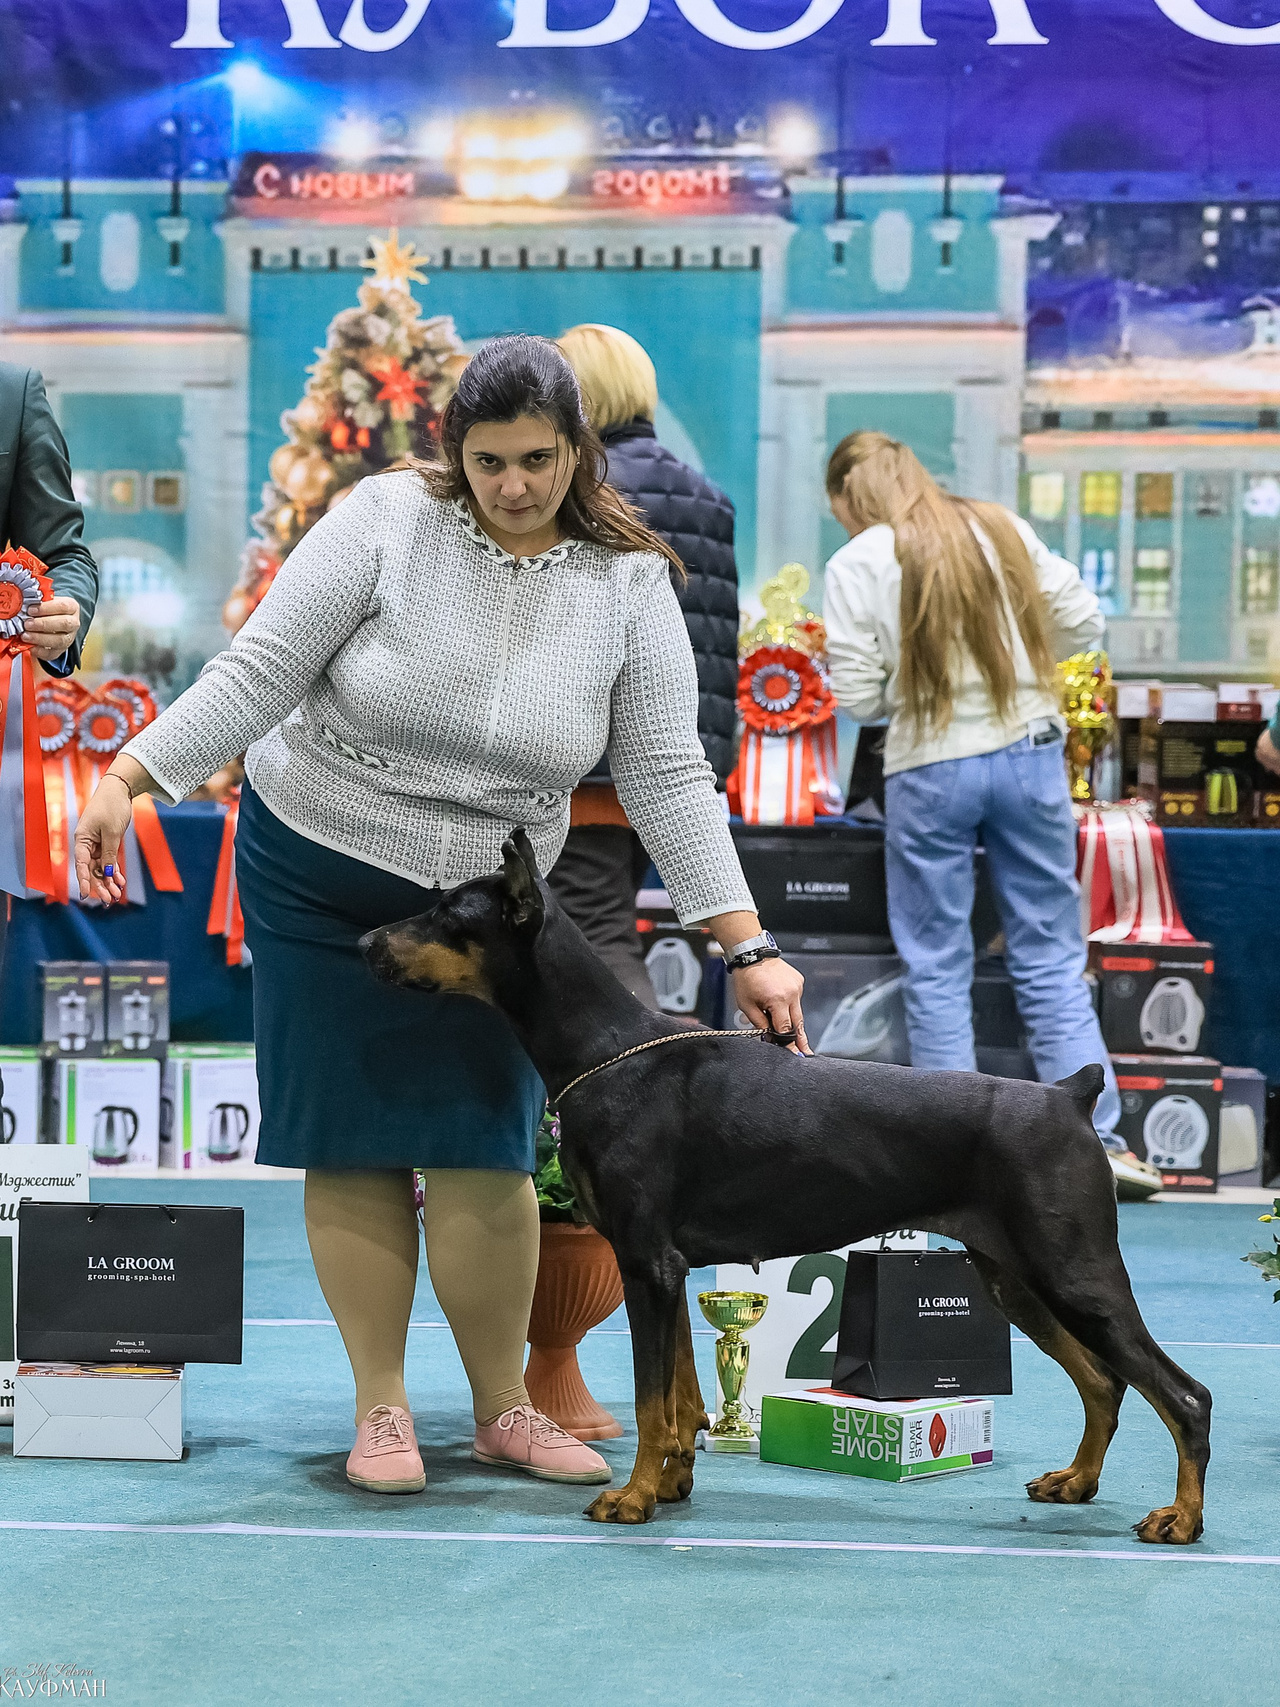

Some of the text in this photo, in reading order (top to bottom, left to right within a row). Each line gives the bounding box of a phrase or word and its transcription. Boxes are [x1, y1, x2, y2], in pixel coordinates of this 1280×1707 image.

[87, 1256, 175, 1270] LA GROOM
[785, 1253, 849, 1379] 2
[918, 1297, 969, 1308] LA GROOM
[832, 1408, 901, 1441] STAR
[908, 1420, 916, 1460] HOME
[915, 1419, 923, 1458] STAR
[831, 1433, 901, 1464] HOME
